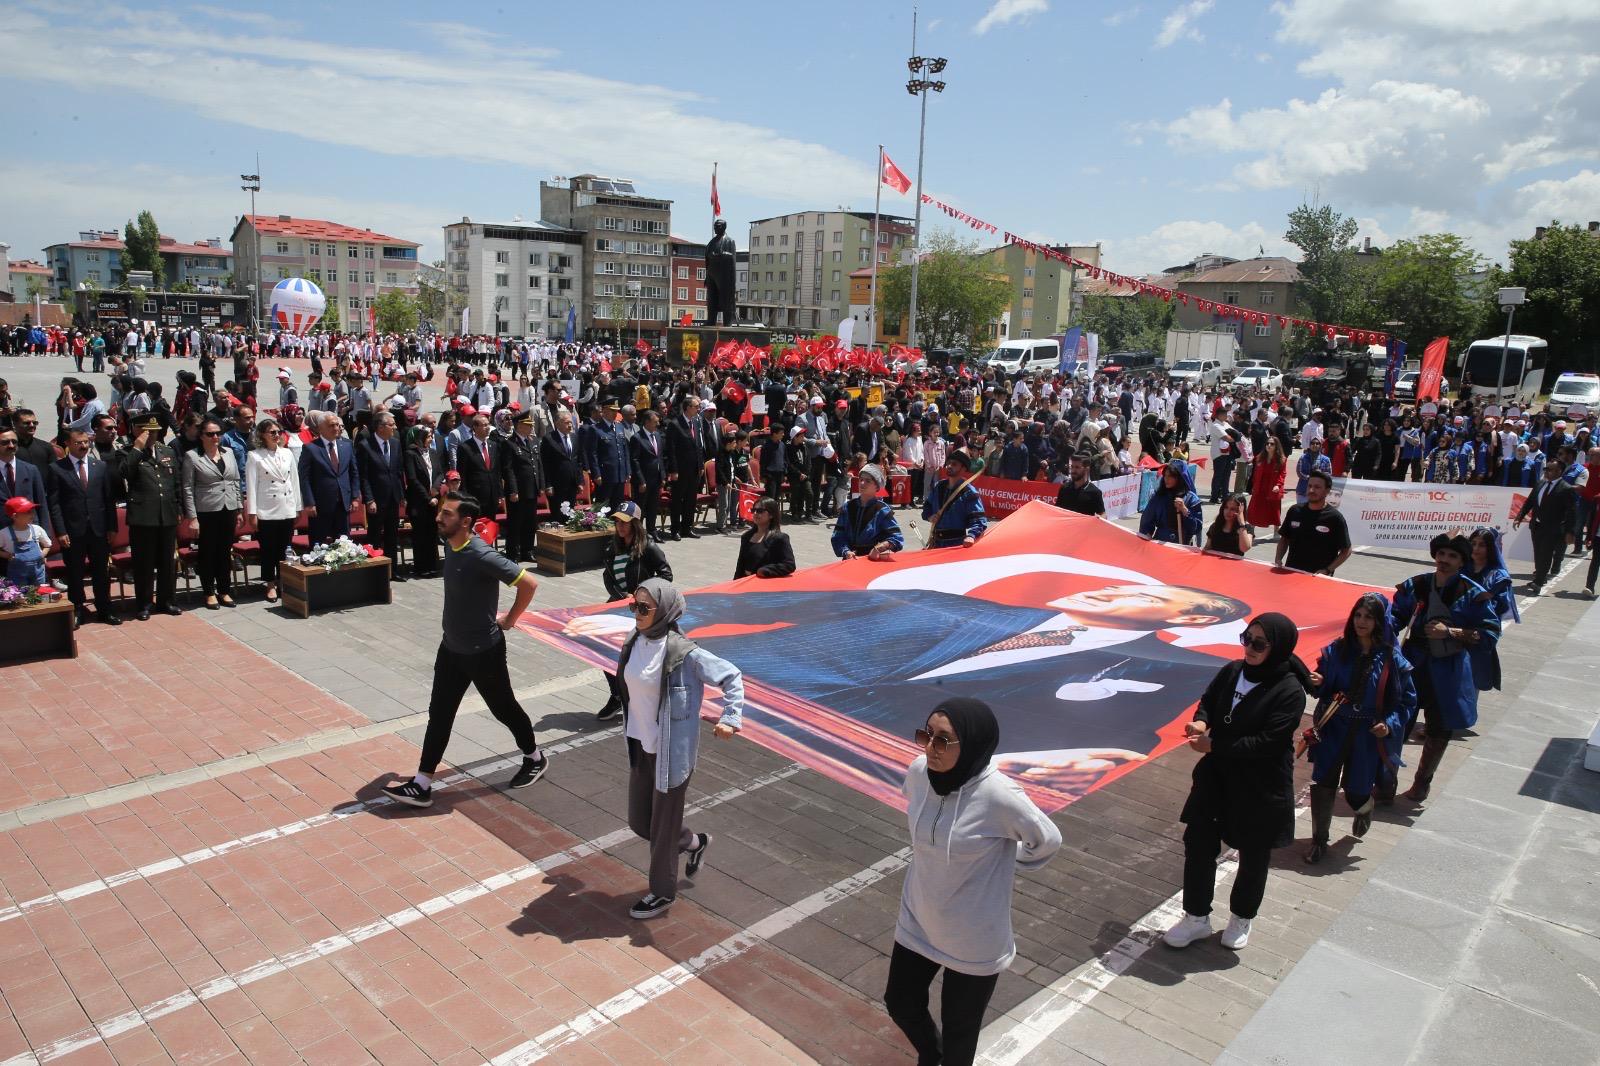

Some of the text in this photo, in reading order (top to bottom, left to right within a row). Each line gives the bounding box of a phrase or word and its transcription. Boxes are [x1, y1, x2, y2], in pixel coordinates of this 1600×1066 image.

[978, 487, 995, 499] MUŞ
[996, 490, 1030, 503] GENÇLİK
[1417, 511, 1446, 522] GÜCÜ
